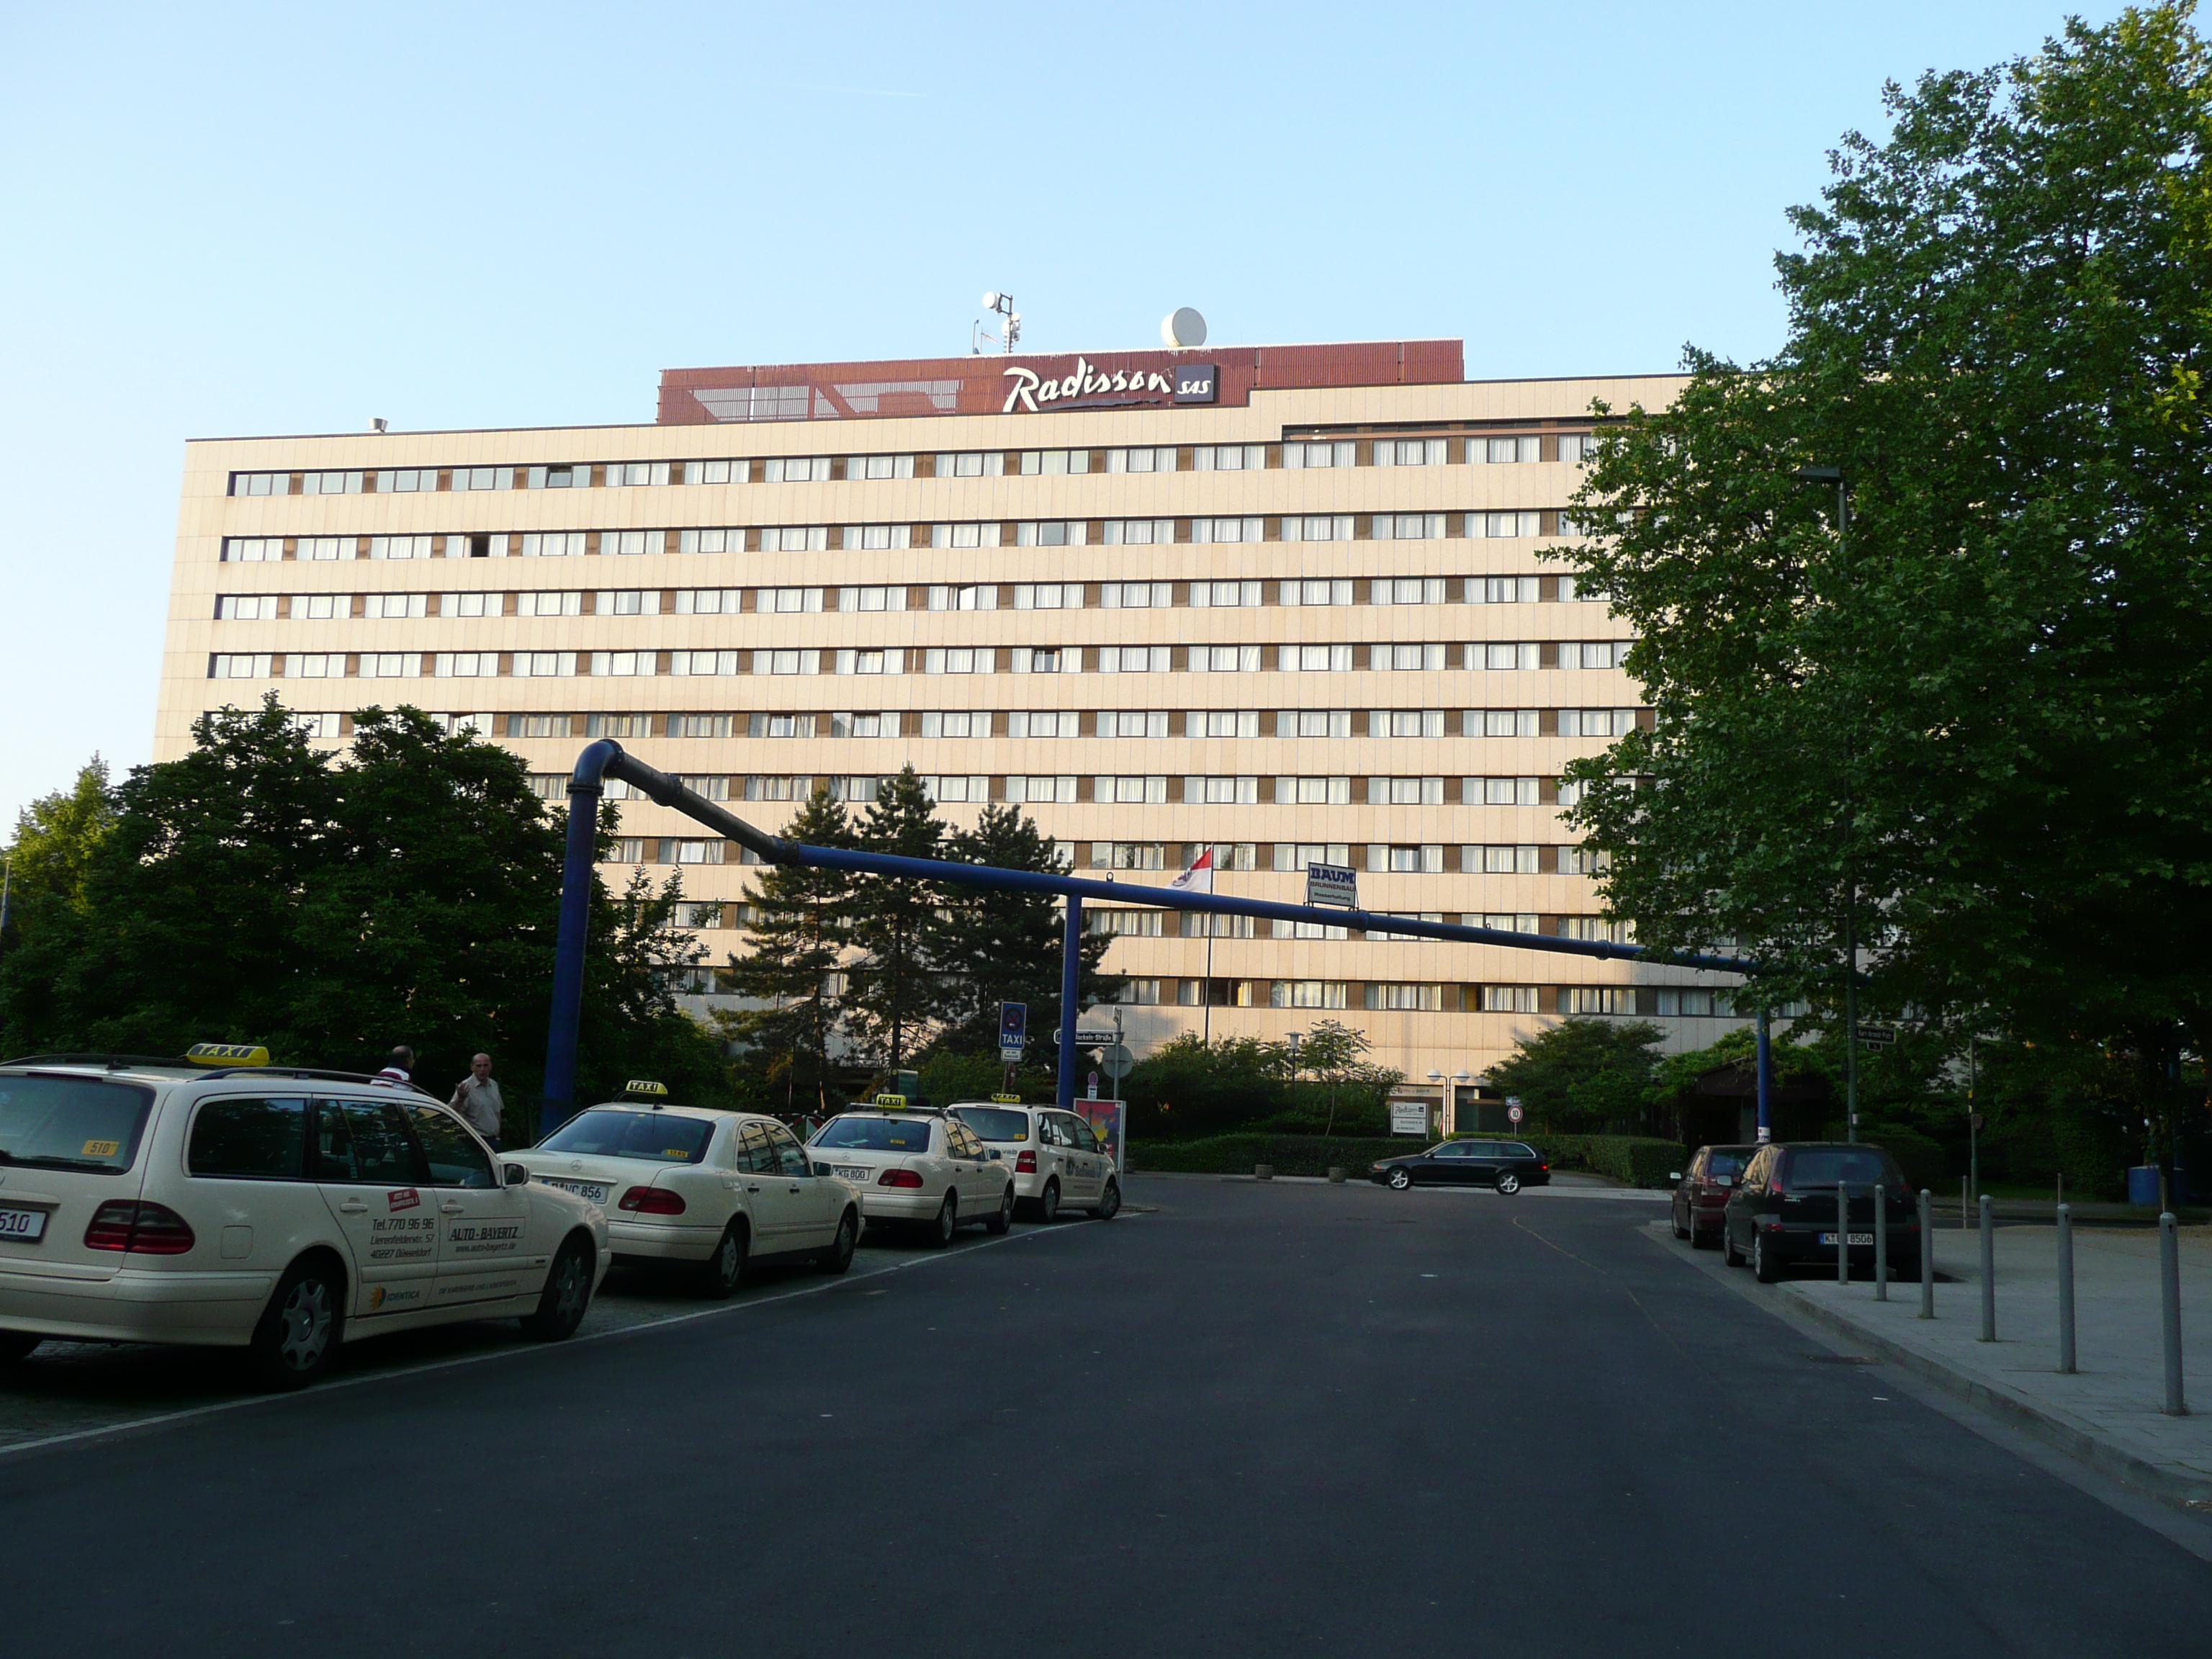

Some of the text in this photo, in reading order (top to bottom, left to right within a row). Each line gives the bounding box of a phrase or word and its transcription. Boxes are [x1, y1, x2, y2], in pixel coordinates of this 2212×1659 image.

[1003, 356, 1210, 412] Radisson SAS
[1310, 868, 1354, 884] BAUM
[1310, 881, 1354, 891] BRUNNENBAU
[1002, 1033, 1022, 1045] TAXI
[197, 1046, 246, 1057] TAXI
[632, 1082, 657, 1091] TAXI
[90, 1142, 110, 1154] 510
[850, 1170, 865, 1179] 800
[581, 1186, 601, 1198] 856
[0, 1213, 30, 1232] 510
[408, 1218, 420, 1229] 96
[422, 1218, 434, 1229] 96
[425, 1233, 434, 1243] 57
[1851, 1234, 1872, 1244] 8506
[370, 1247, 431, 1259] 40227 Düsseldorf
[387, 1289, 420, 1301] IDENTICA
